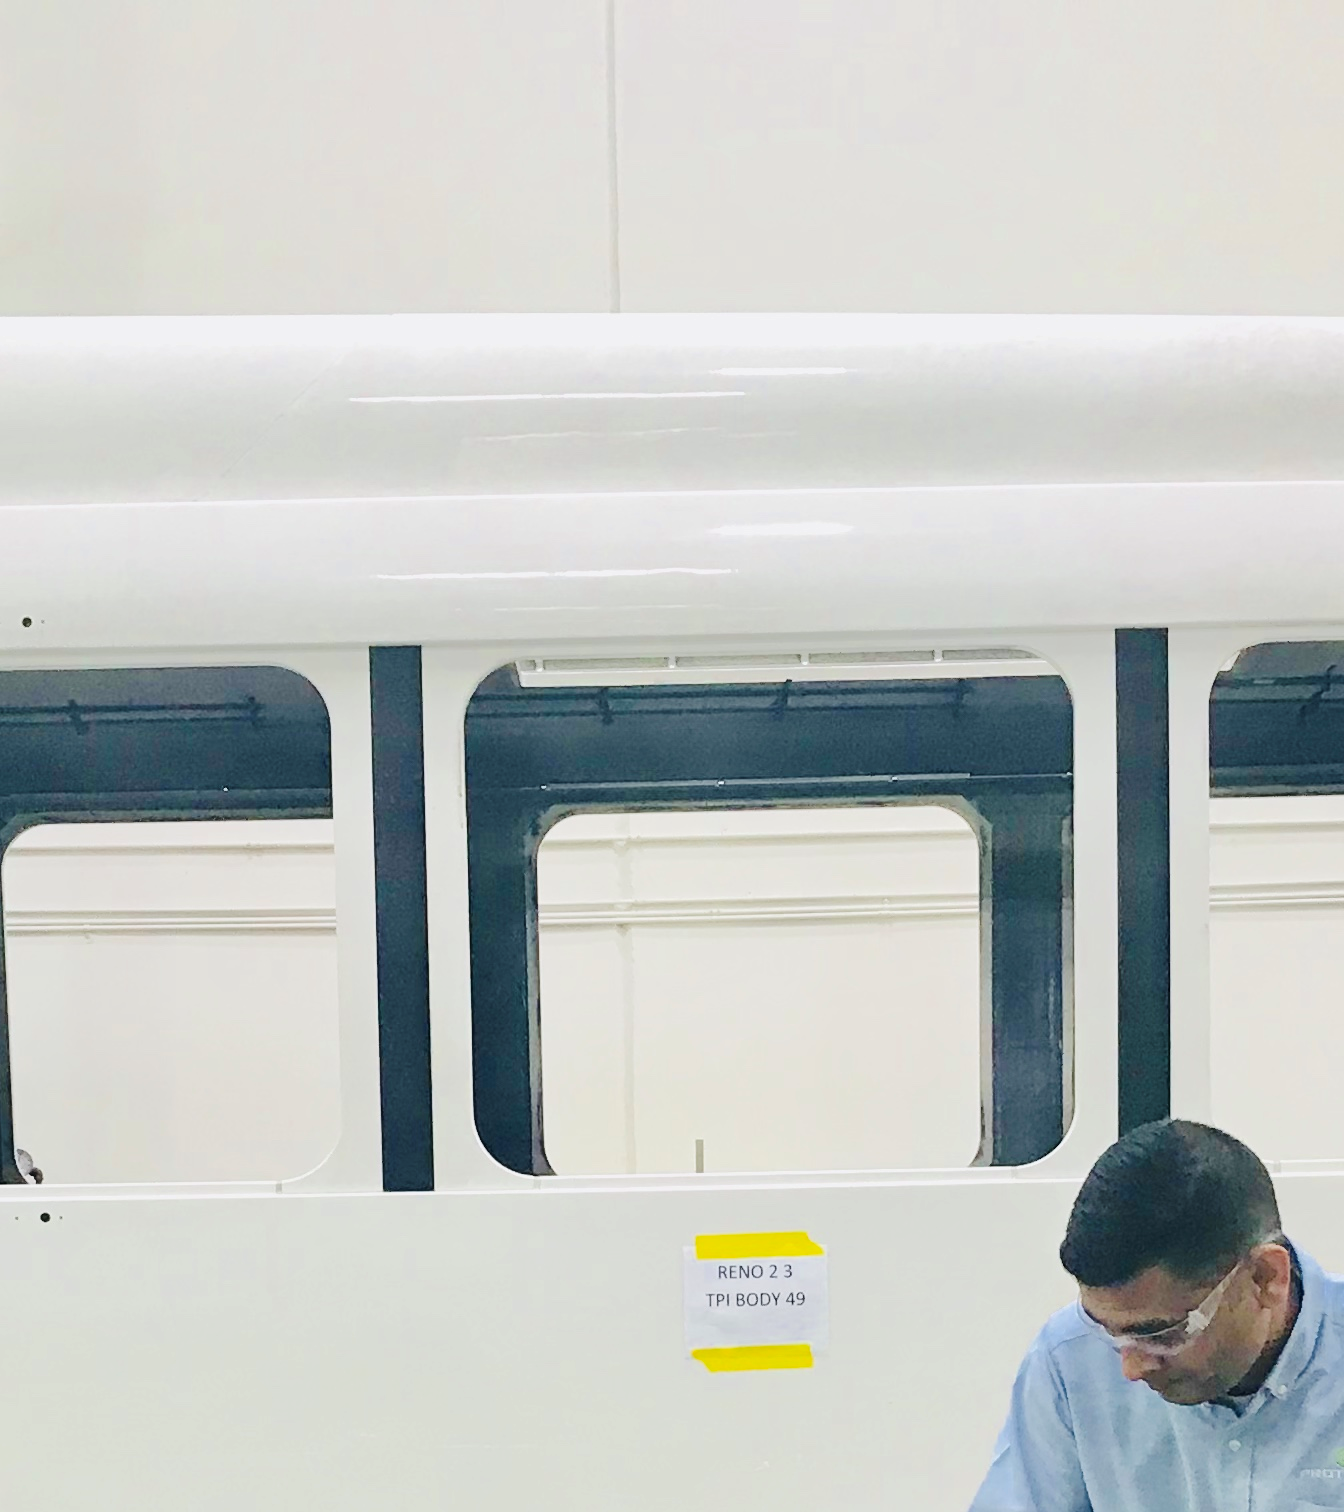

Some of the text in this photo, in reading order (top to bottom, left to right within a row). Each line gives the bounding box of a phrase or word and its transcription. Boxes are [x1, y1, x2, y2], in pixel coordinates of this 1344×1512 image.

[718, 1264, 793, 1279] RENO 2 3
[705, 1291, 806, 1307] TPI BODY 49
